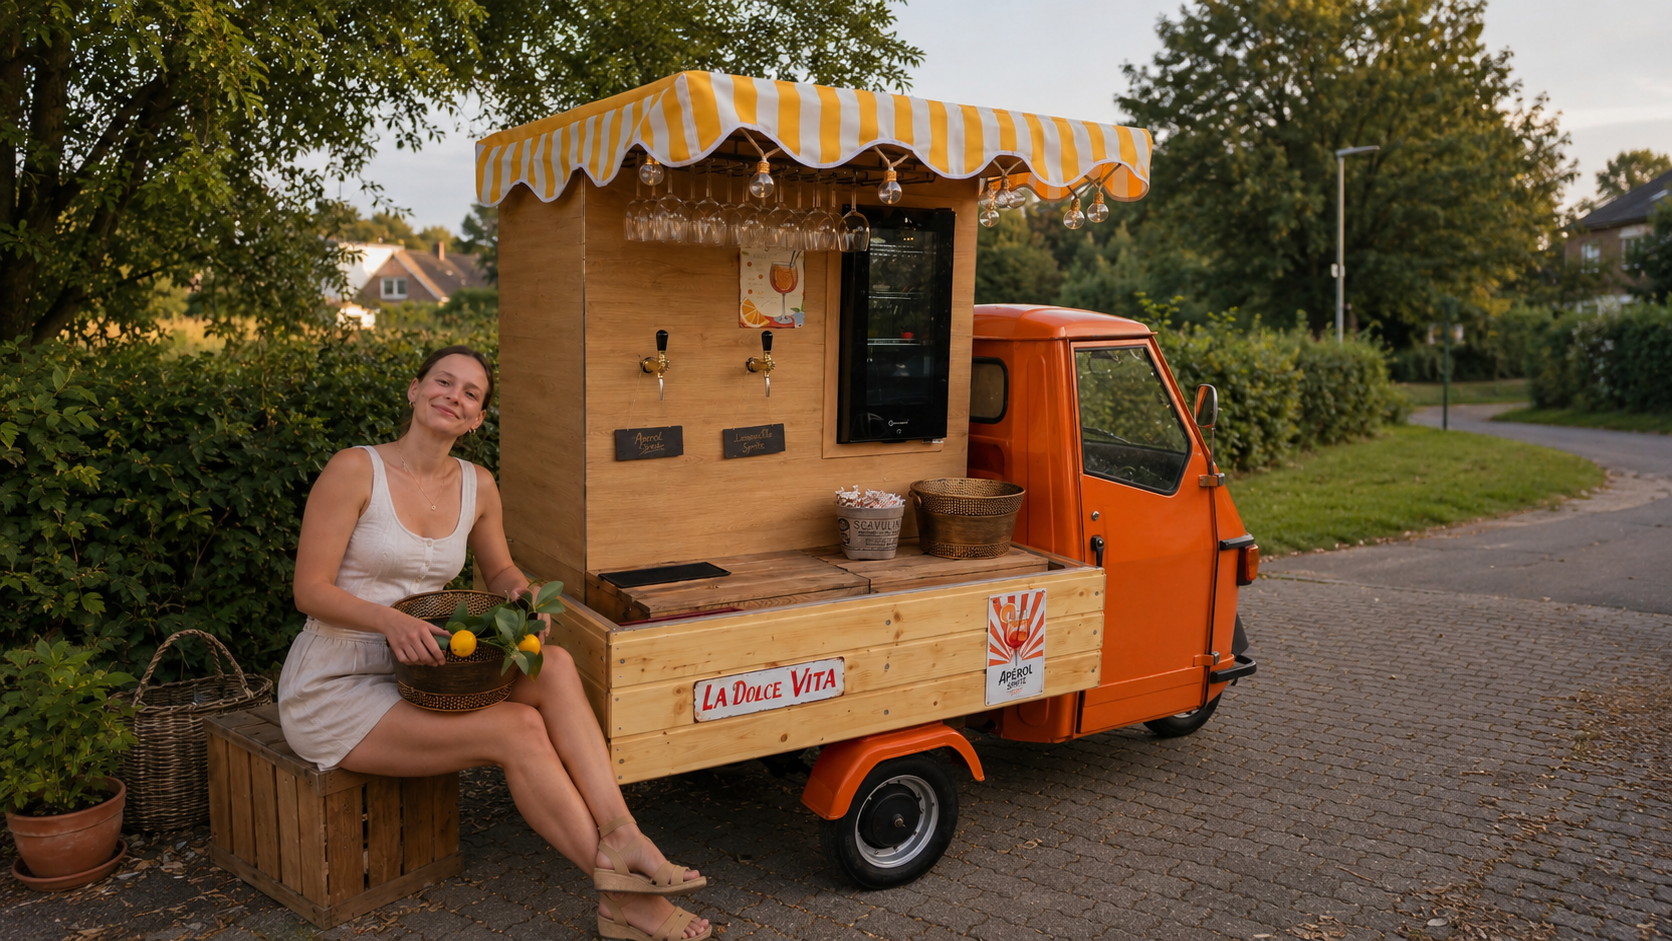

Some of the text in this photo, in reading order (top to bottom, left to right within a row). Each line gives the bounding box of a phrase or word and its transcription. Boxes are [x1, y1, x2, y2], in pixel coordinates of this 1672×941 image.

[702, 667, 836, 711] LA DOLCE VITA
